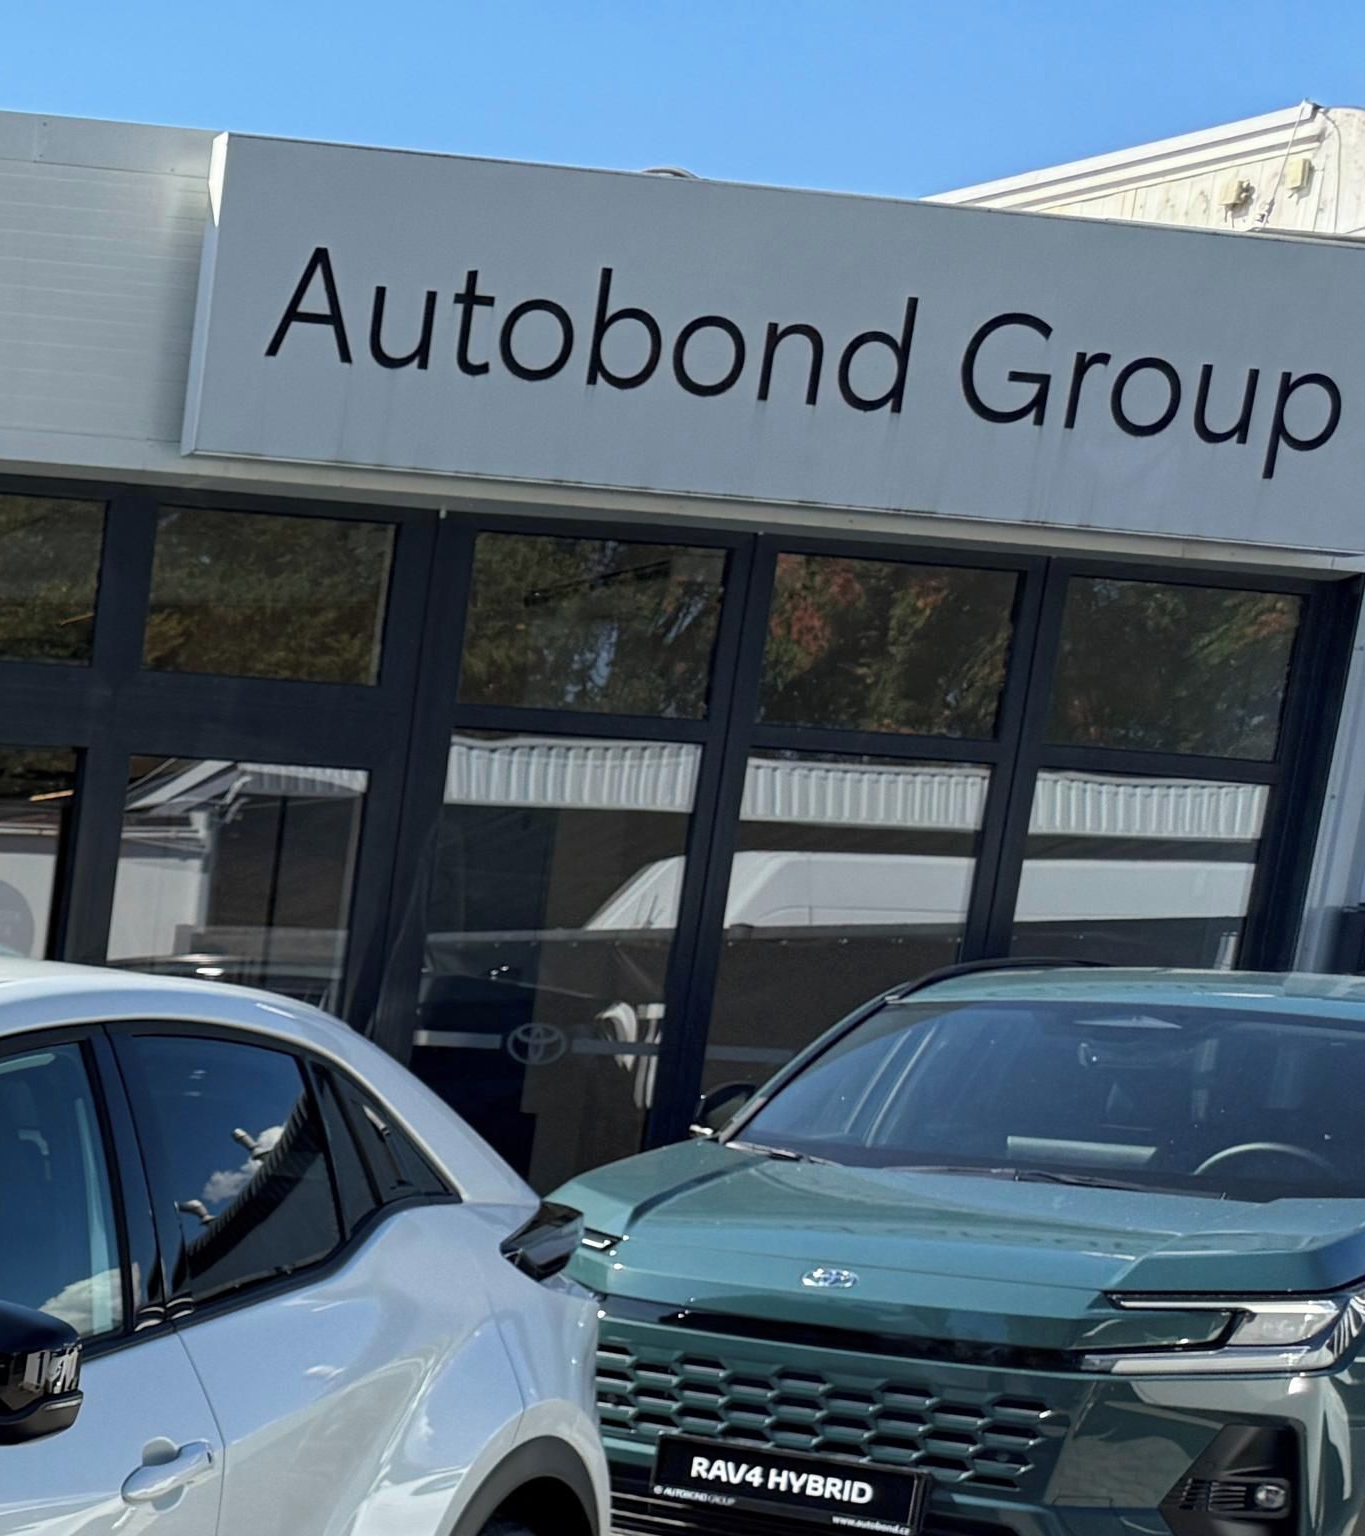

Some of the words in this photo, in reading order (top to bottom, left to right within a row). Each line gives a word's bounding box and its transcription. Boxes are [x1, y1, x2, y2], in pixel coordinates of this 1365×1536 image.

[265, 246, 920, 414] Autobond
[961, 311, 1343, 480] Group
[690, 1455, 764, 1488] RAV4
[767, 1467, 874, 1505] HYBRID
